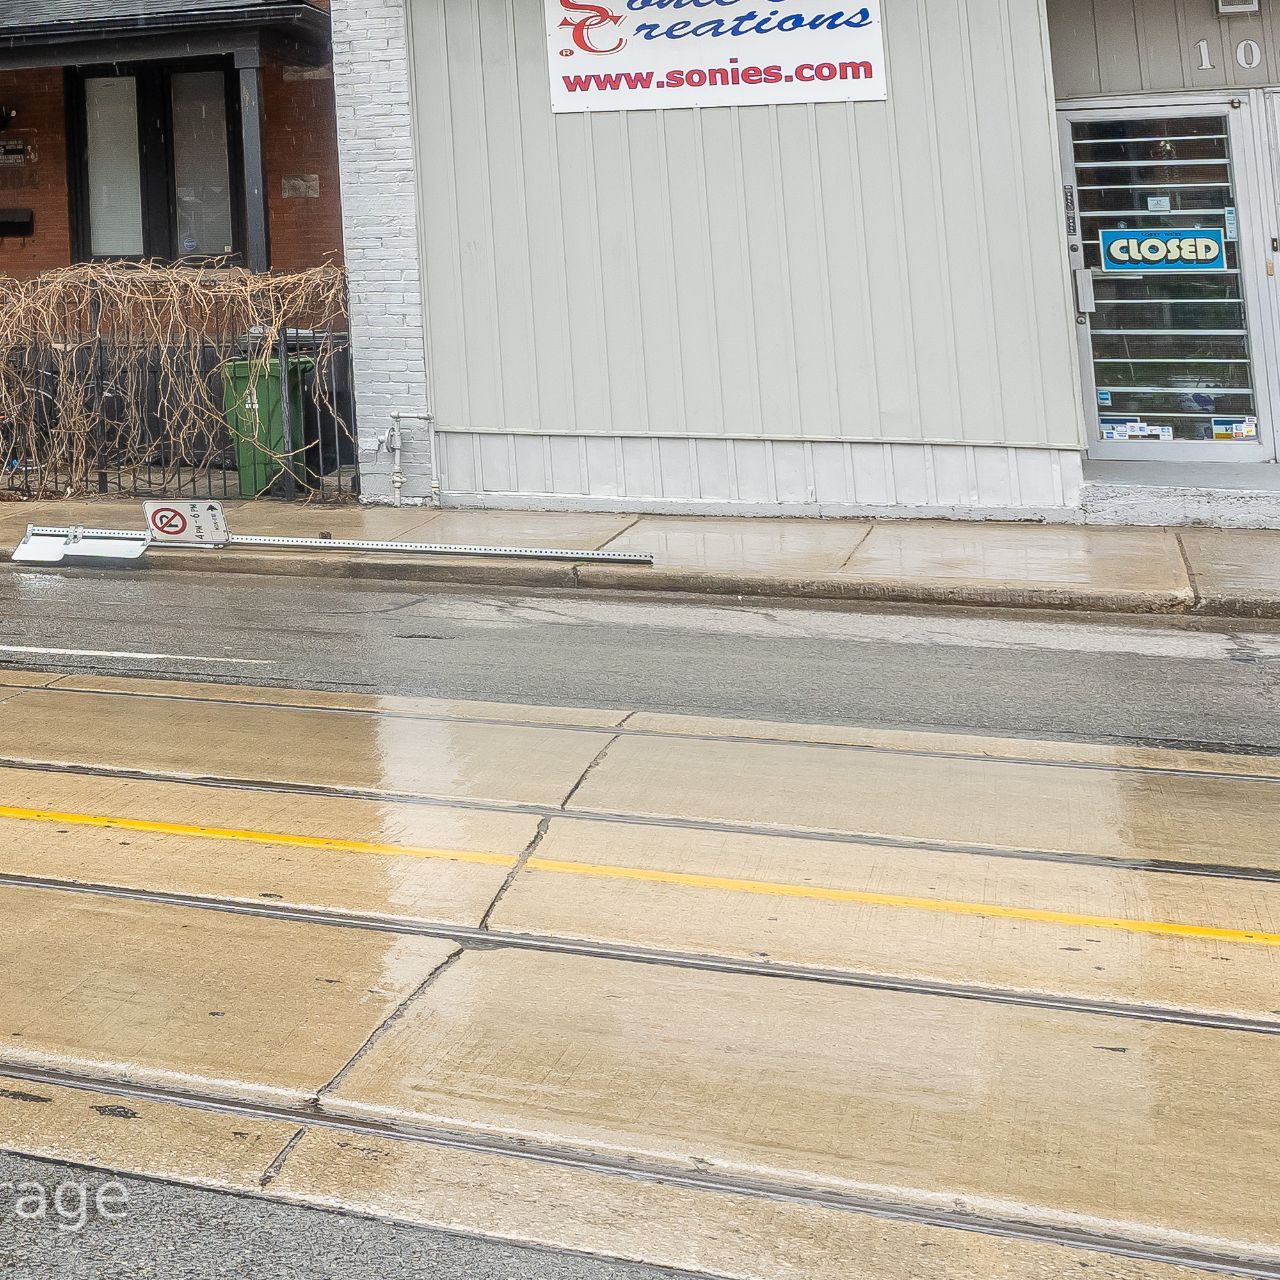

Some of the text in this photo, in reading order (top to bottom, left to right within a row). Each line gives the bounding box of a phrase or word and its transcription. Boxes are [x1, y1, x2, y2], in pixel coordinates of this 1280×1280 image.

[572, 7, 874, 56] Creations
[561, 58, 874, 93] www.sonies.com
[1108, 237, 1220, 264] CLOSED
